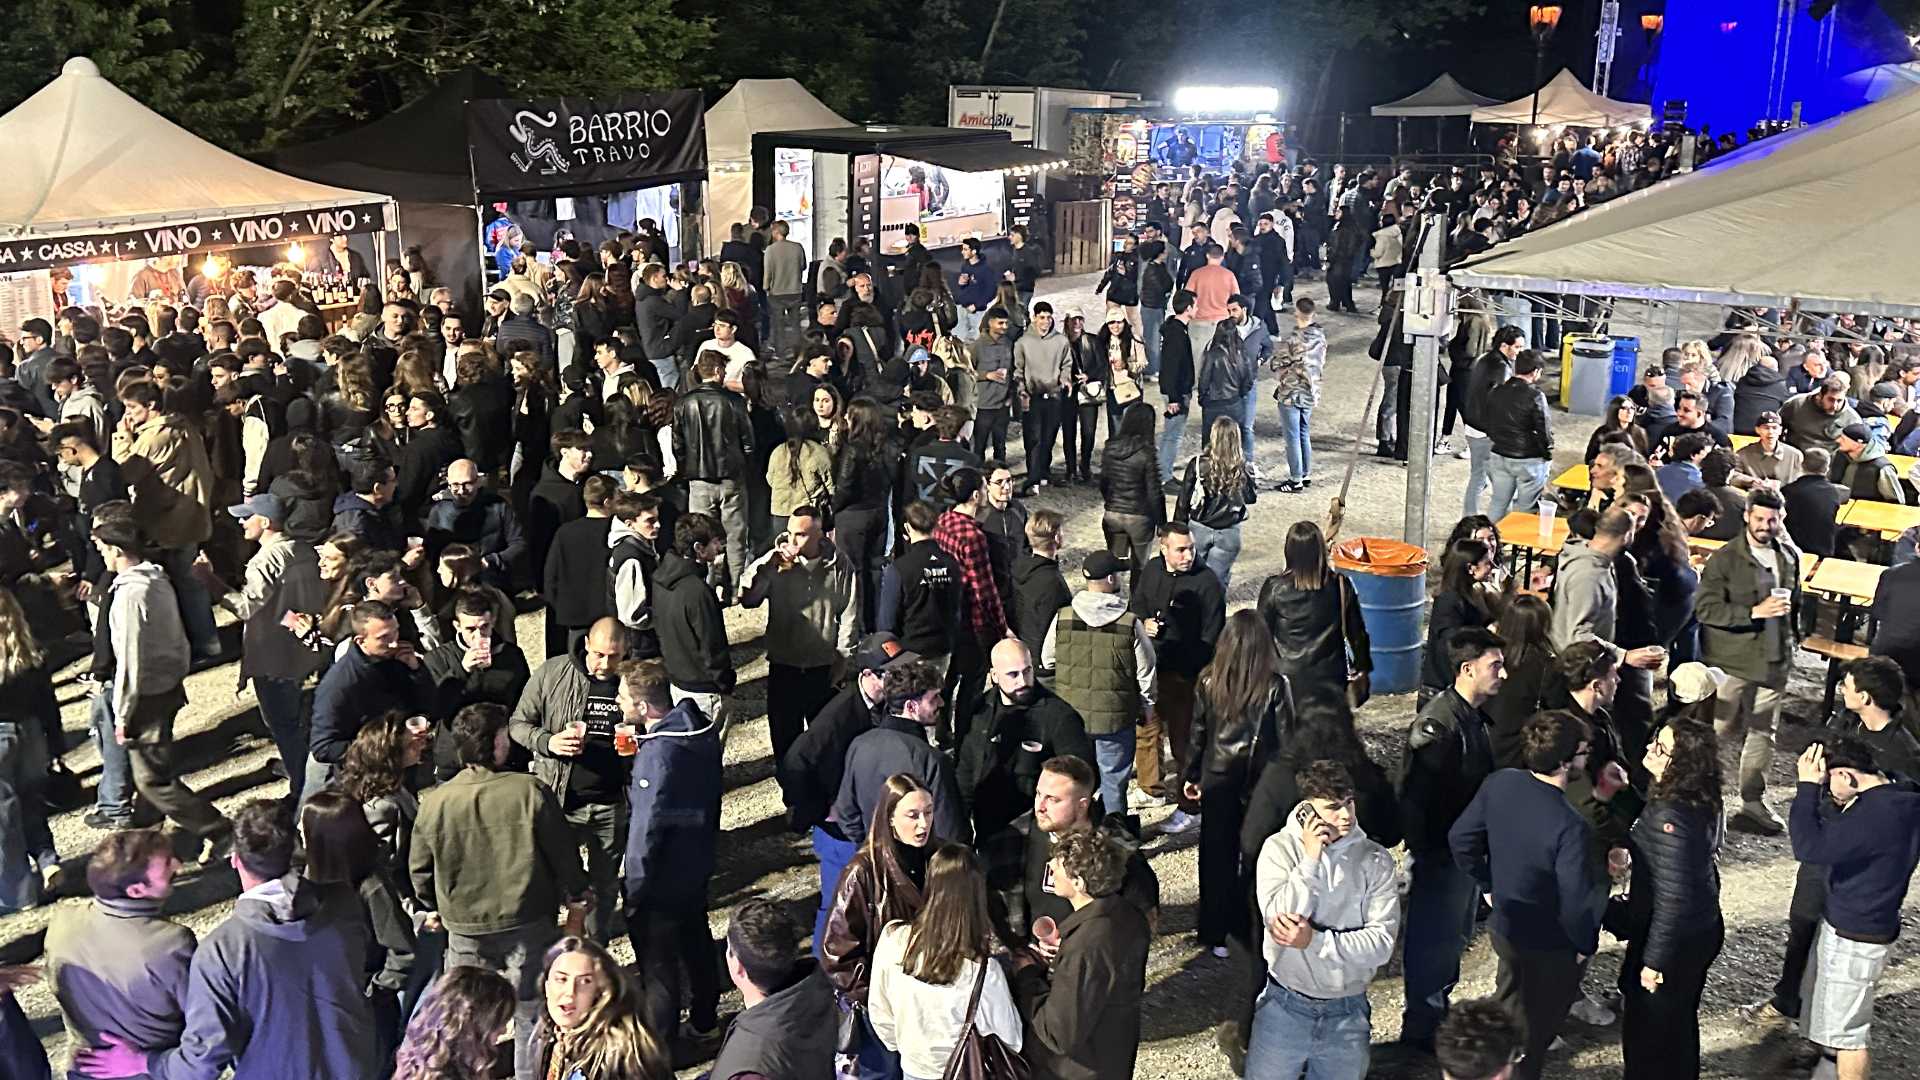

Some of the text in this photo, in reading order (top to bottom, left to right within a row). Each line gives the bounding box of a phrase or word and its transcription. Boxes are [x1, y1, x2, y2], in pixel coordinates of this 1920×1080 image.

[569, 109, 671, 144] BARRIO
[573, 143, 650, 165] TRAVO
[144, 226, 201, 253] VINO
[230, 217, 283, 244] VINO
[307, 210, 356, 235] VINO
[38, 241, 97, 261] CASSA
[593, 702, 619, 711] WOOD
